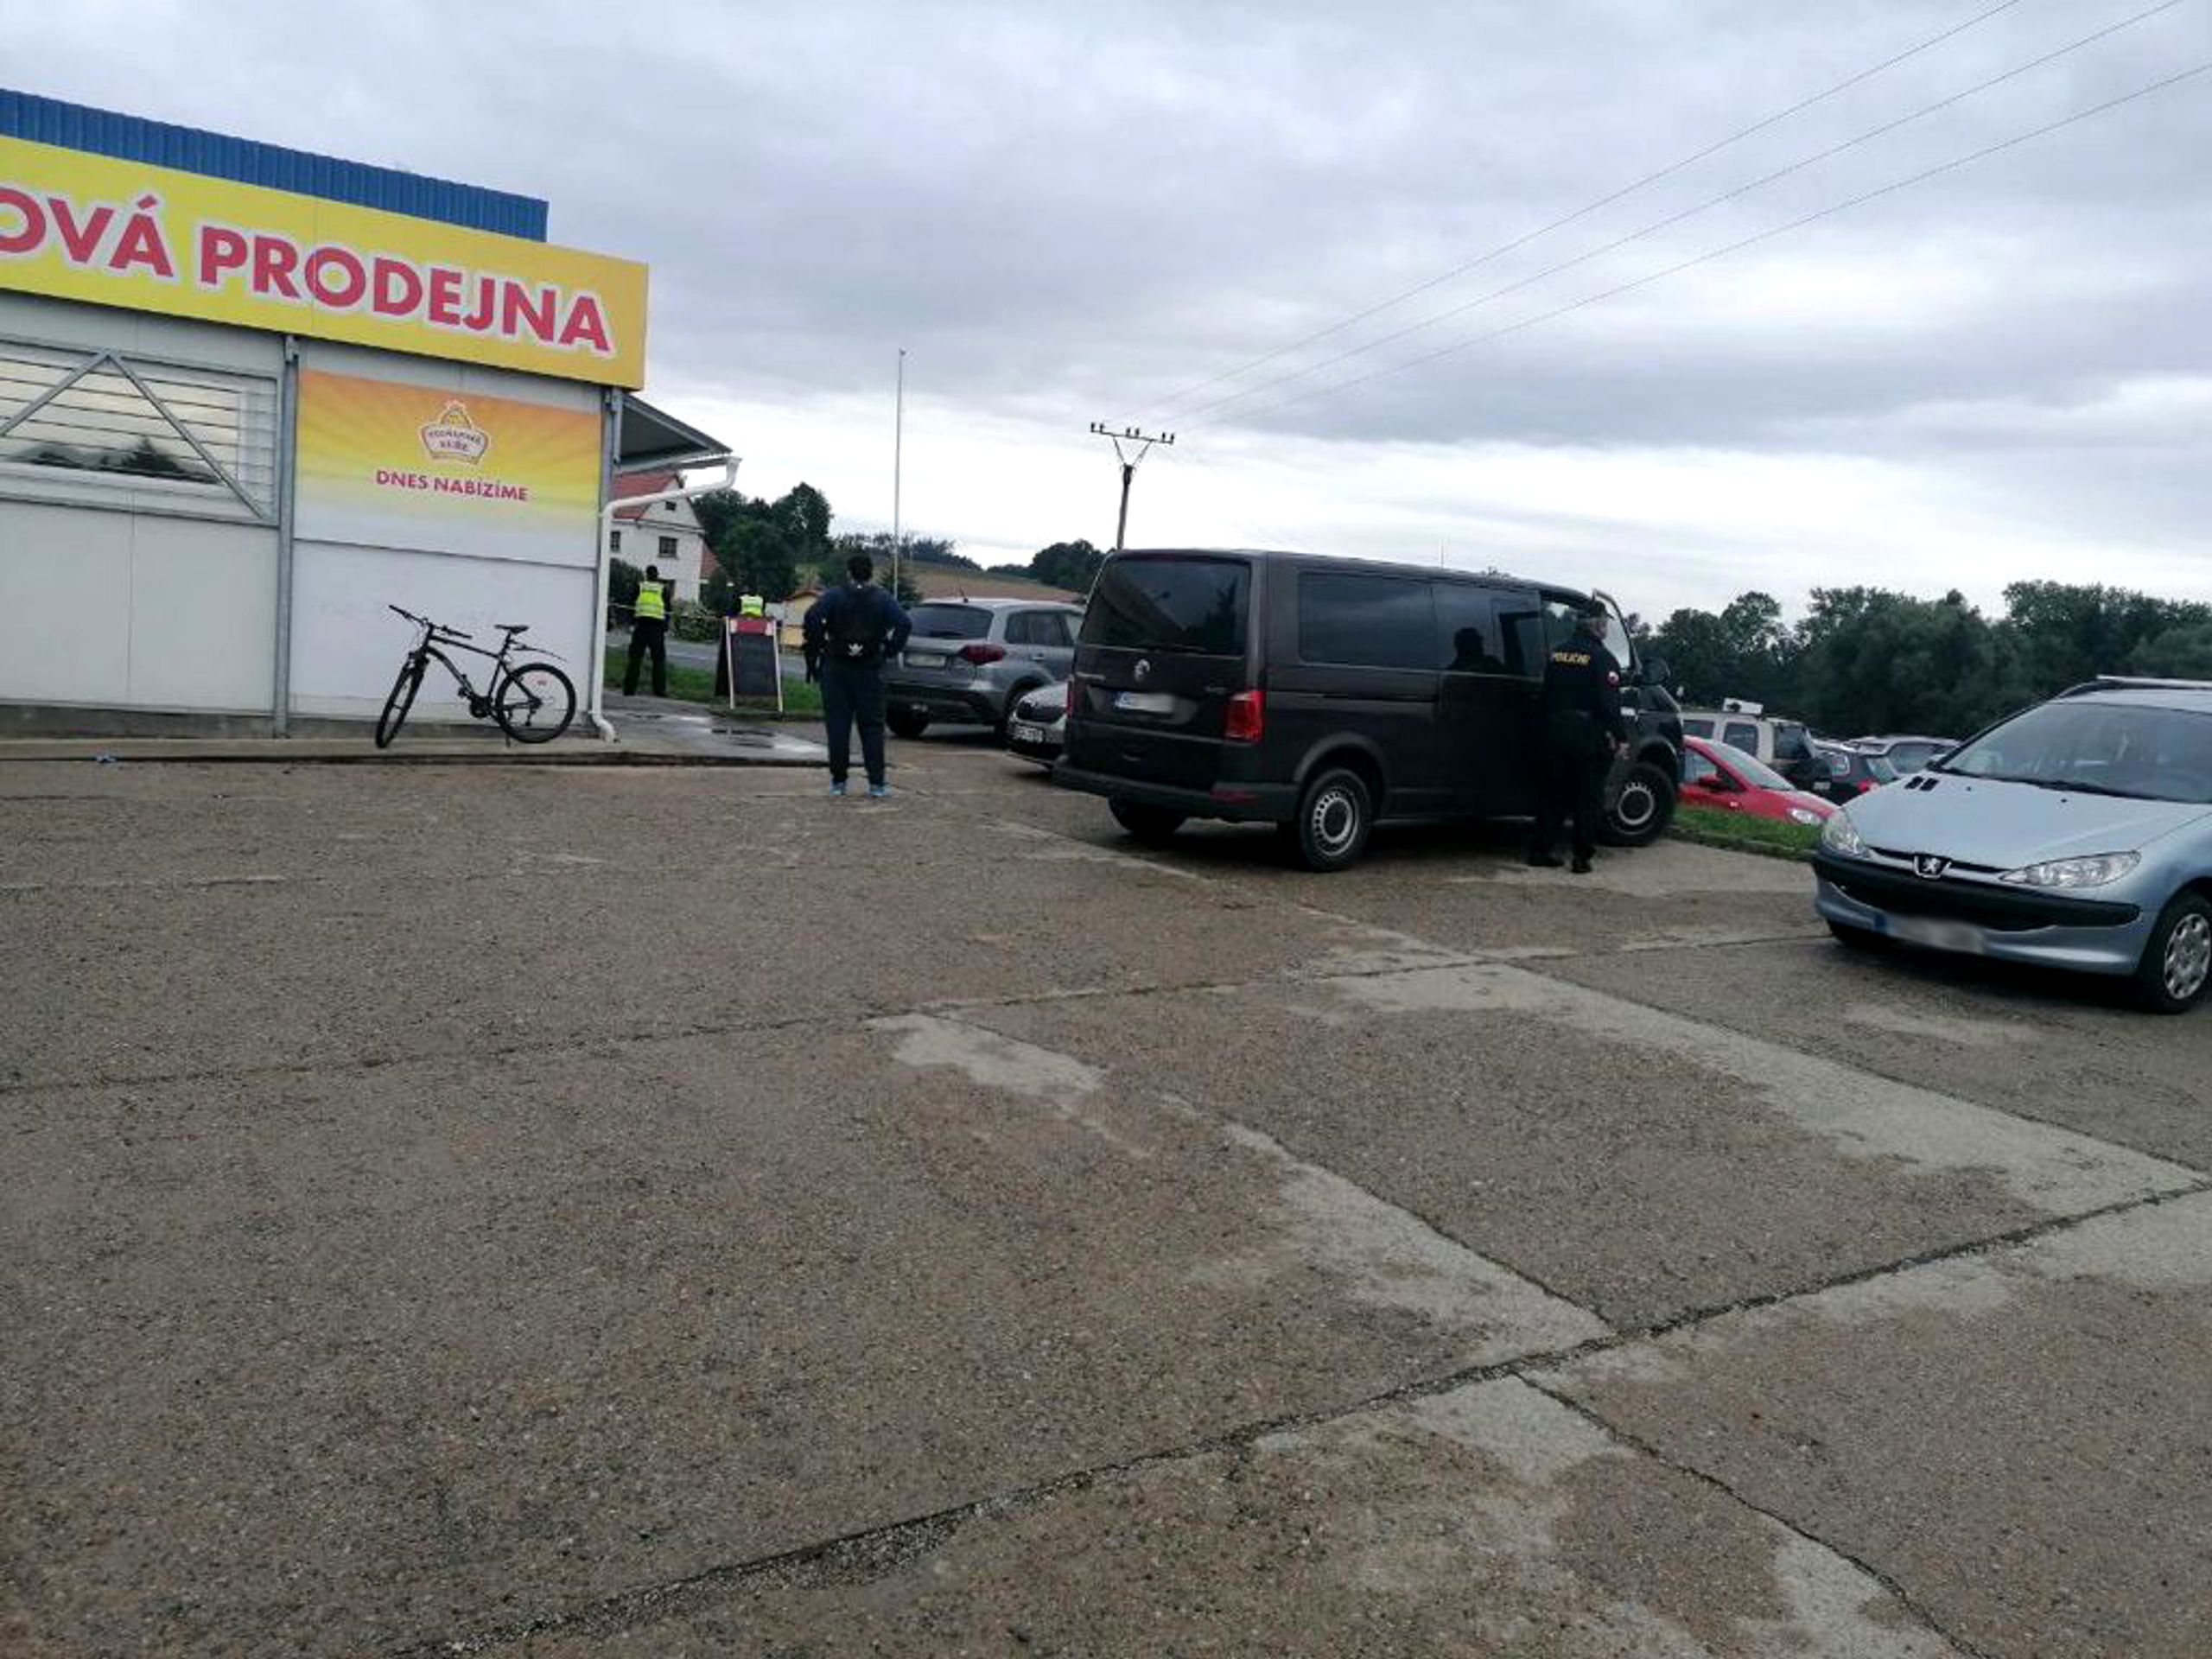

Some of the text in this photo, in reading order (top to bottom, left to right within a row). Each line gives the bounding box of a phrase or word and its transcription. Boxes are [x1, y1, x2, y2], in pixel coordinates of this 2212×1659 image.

[200, 226, 612, 351] PRODEJNA
[376, 470, 529, 500] DNES NABÍZÍME
